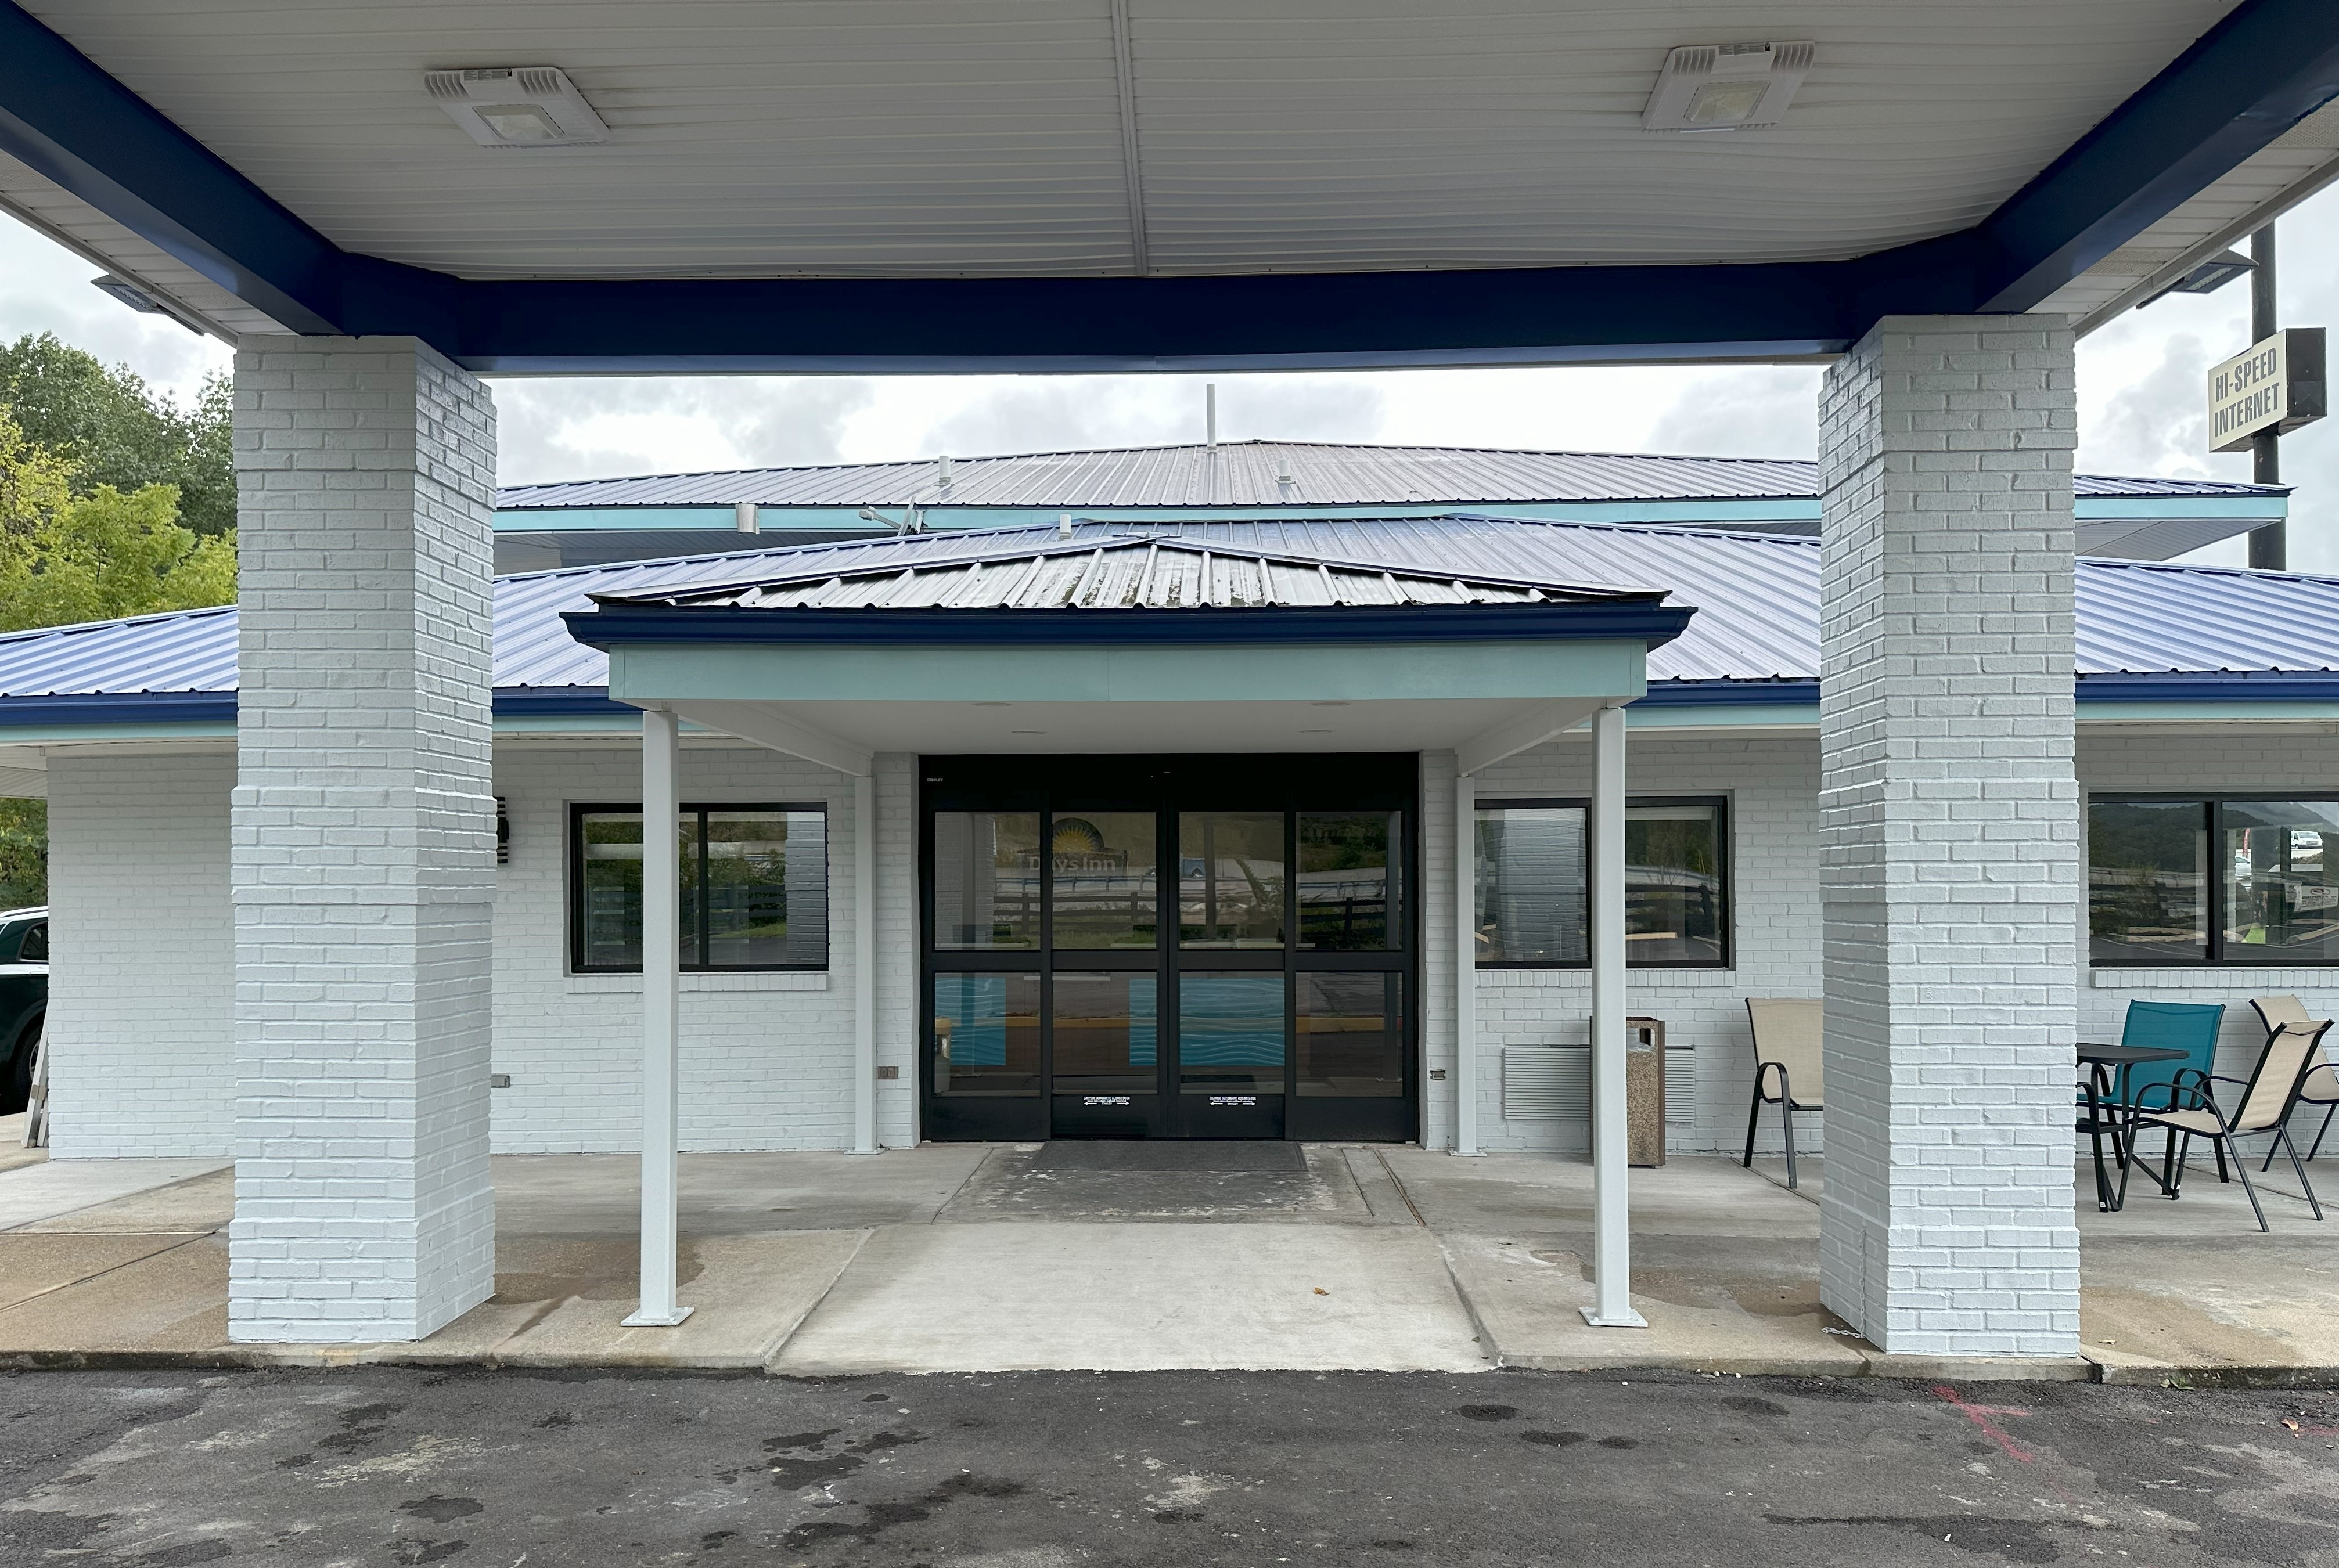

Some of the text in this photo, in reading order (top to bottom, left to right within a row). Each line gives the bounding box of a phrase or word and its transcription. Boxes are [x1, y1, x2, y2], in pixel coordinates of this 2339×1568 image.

[2216, 348, 2276, 402] HI-SPEED
[2215, 382, 2279, 438] INTERNET
[1082, 857, 1116, 871] Inn
